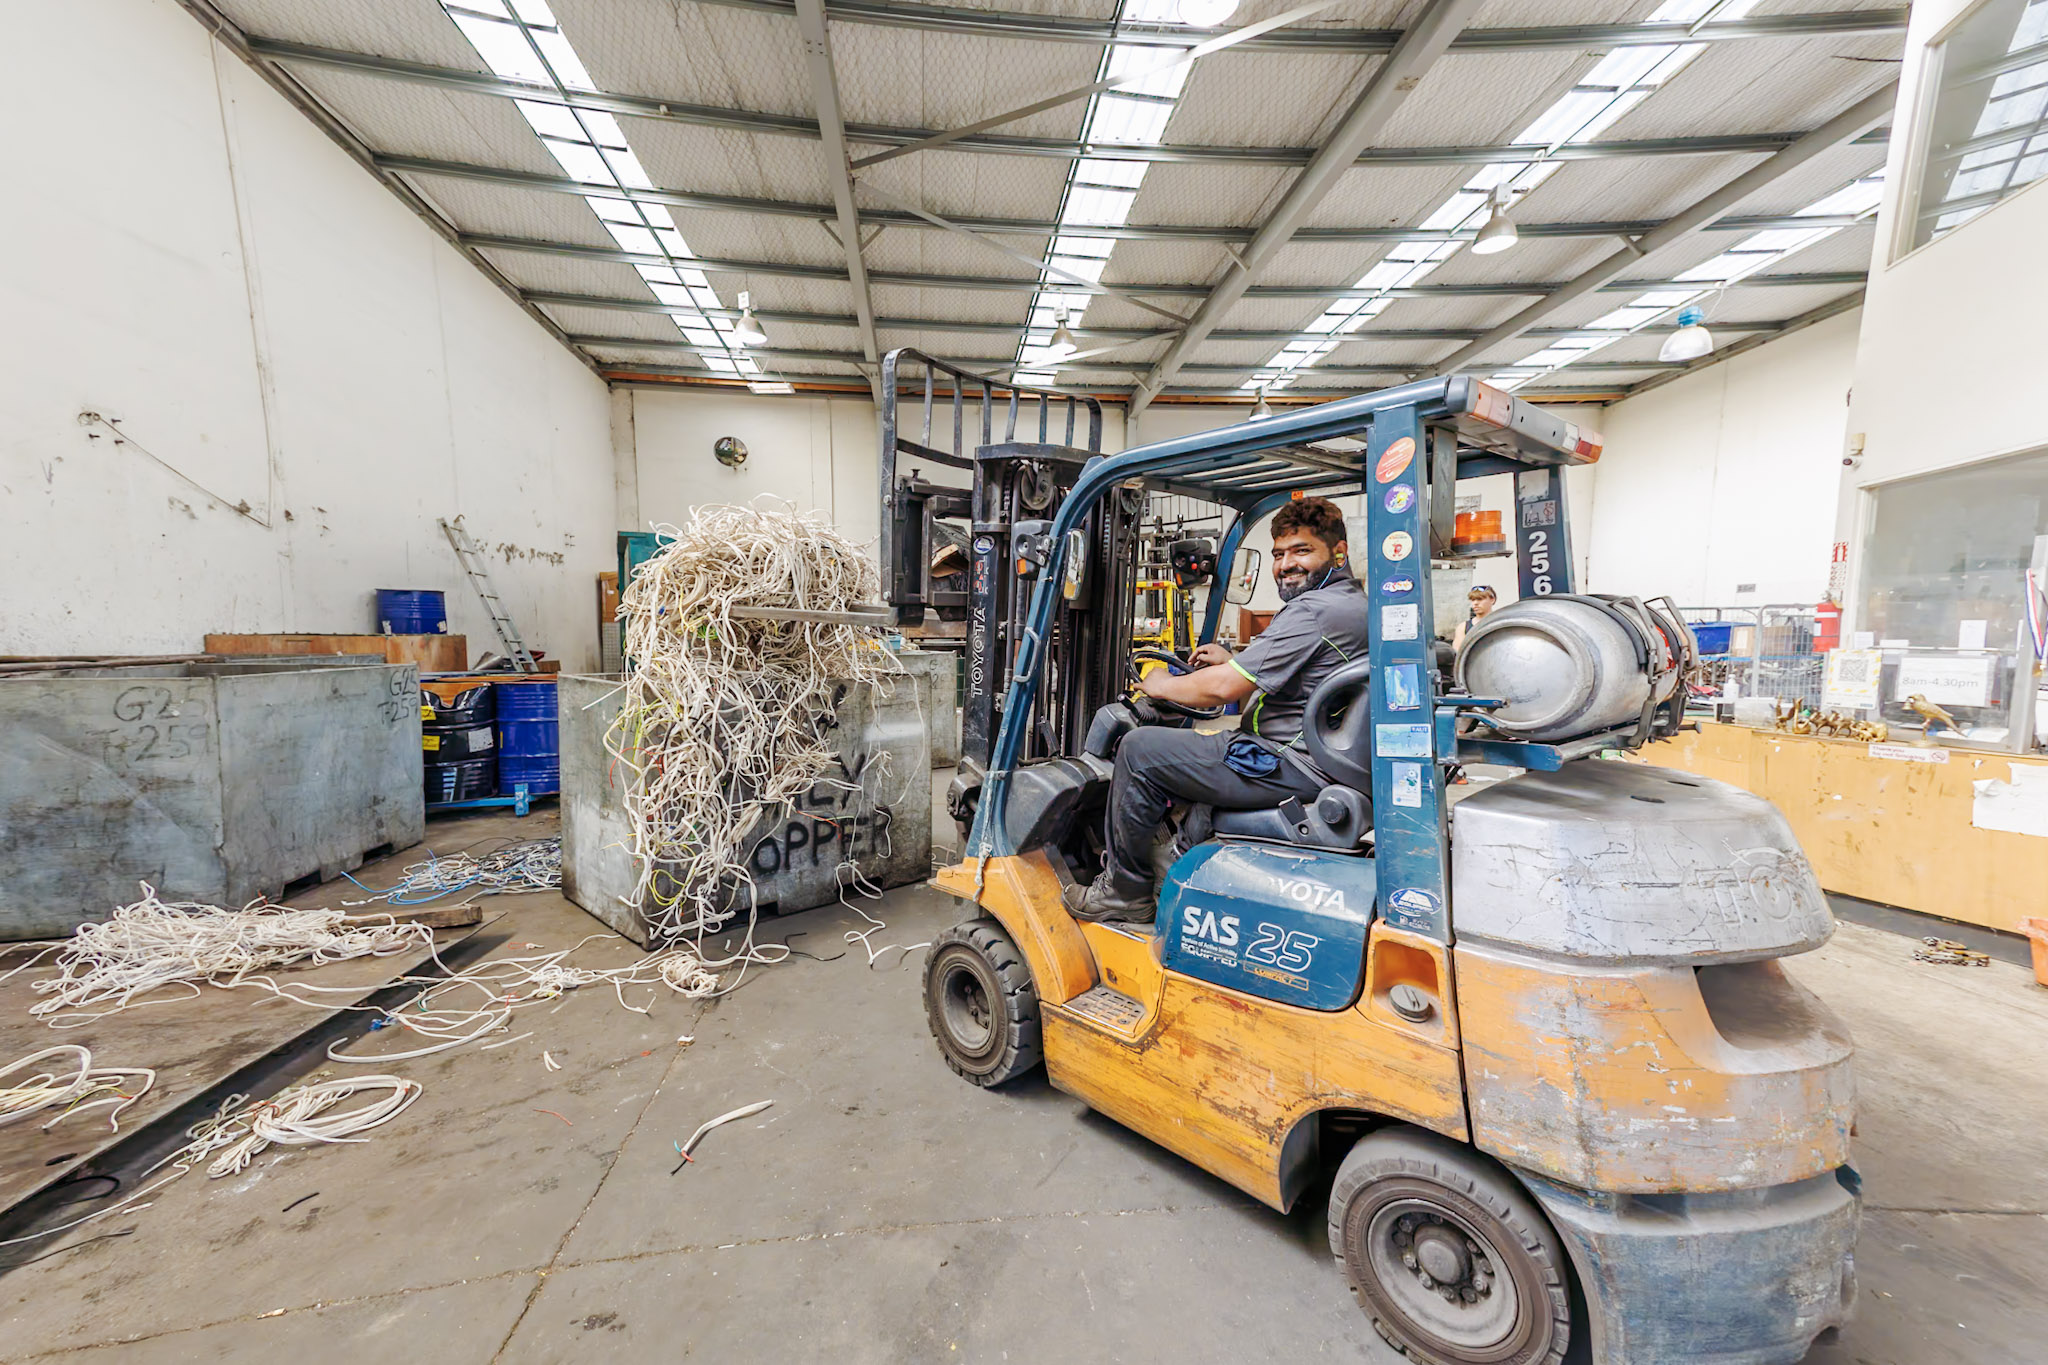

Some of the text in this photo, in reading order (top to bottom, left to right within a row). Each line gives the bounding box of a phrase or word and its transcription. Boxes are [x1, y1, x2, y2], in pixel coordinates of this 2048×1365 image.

[1528, 530, 1553, 596] 256
[971, 606, 986, 698] TOYOTA
[389, 668, 418, 697] G25
[1902, 676, 1979, 689] 8am-4.30pm
[751, 804, 893, 876] OPPER
[1182, 906, 1240, 947] SAS
[1245, 922, 1319, 972] 25
